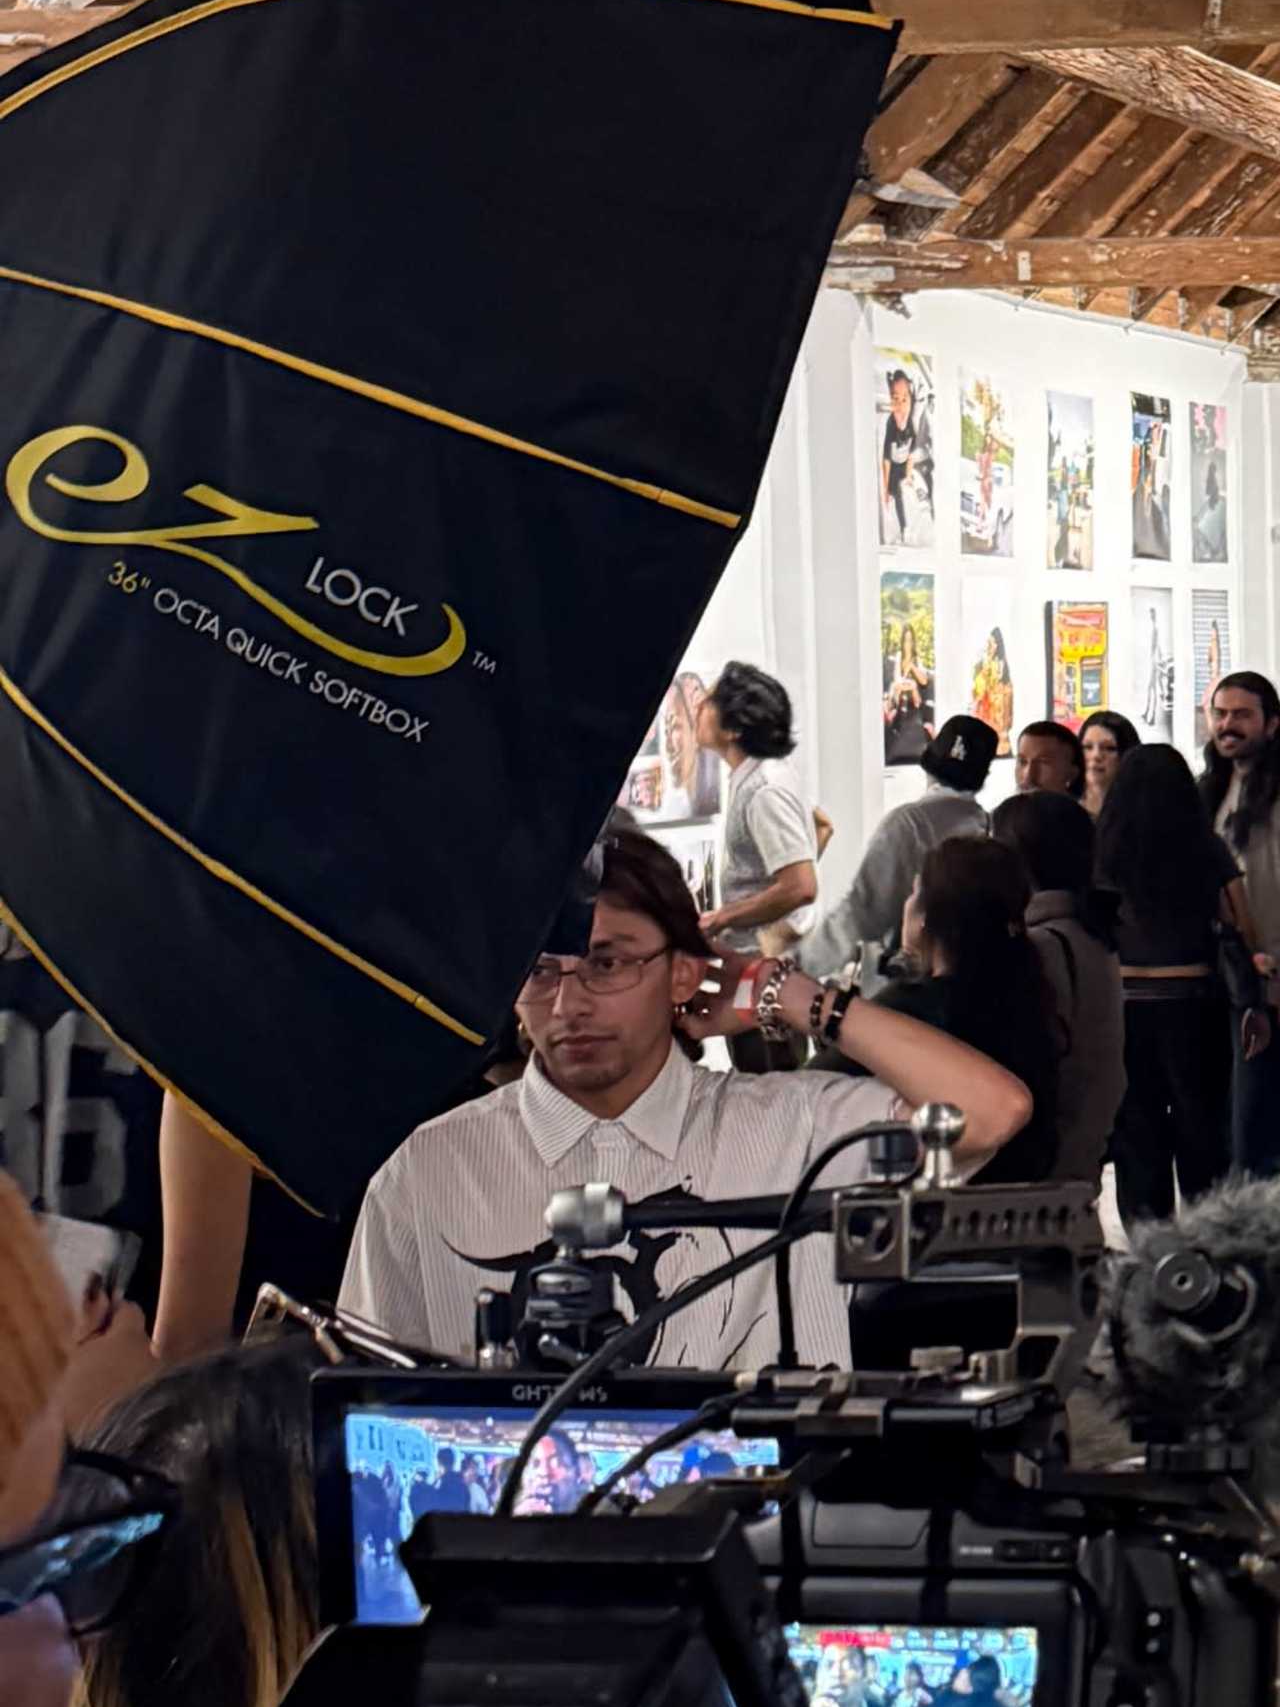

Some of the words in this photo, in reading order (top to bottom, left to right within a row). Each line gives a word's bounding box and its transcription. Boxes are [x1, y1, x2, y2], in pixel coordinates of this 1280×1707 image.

[305, 557, 419, 636] LOCK
[153, 588, 220, 641] OCTA
[226, 628, 308, 684] QUICK
[309, 671, 429, 743] SOFTBOX
